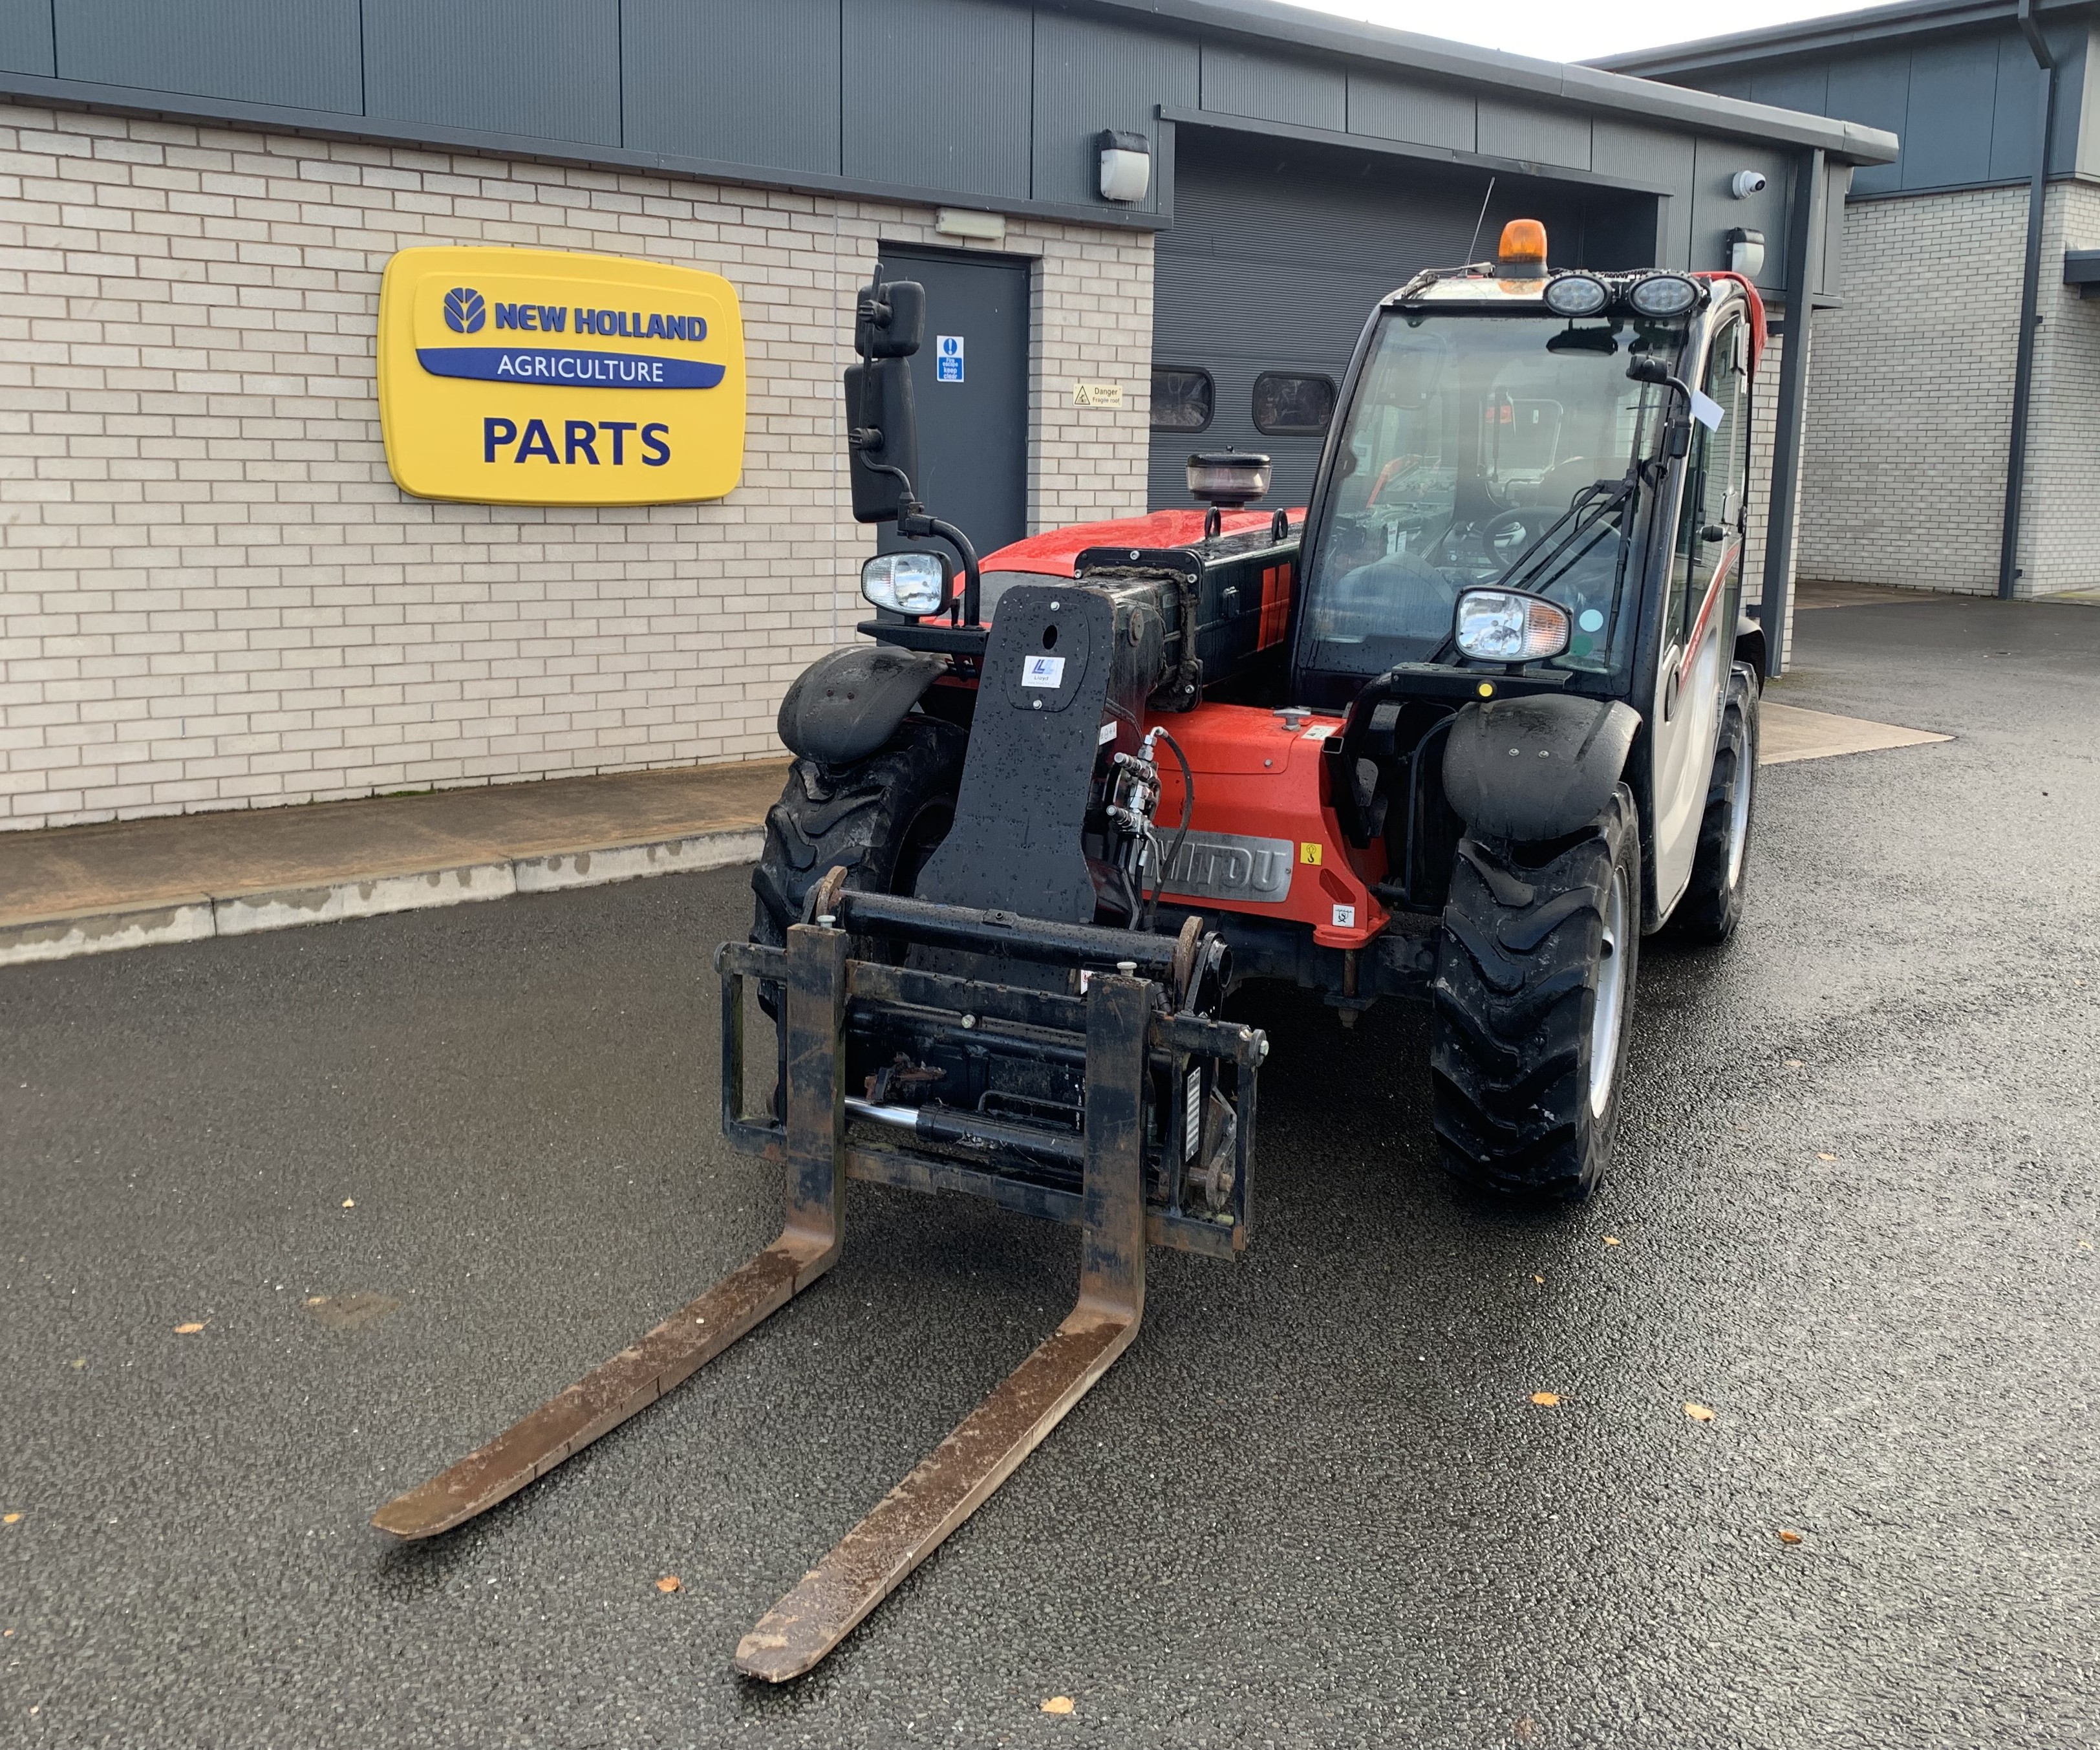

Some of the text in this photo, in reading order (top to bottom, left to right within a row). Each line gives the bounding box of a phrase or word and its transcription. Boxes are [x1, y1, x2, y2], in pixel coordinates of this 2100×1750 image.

[495, 302, 707, 341] NEW HOLLAND
[497, 354, 664, 382] AGRICULTURE
[1095, 387, 1118, 397] Danger
[483, 416, 671, 466] PARTS
